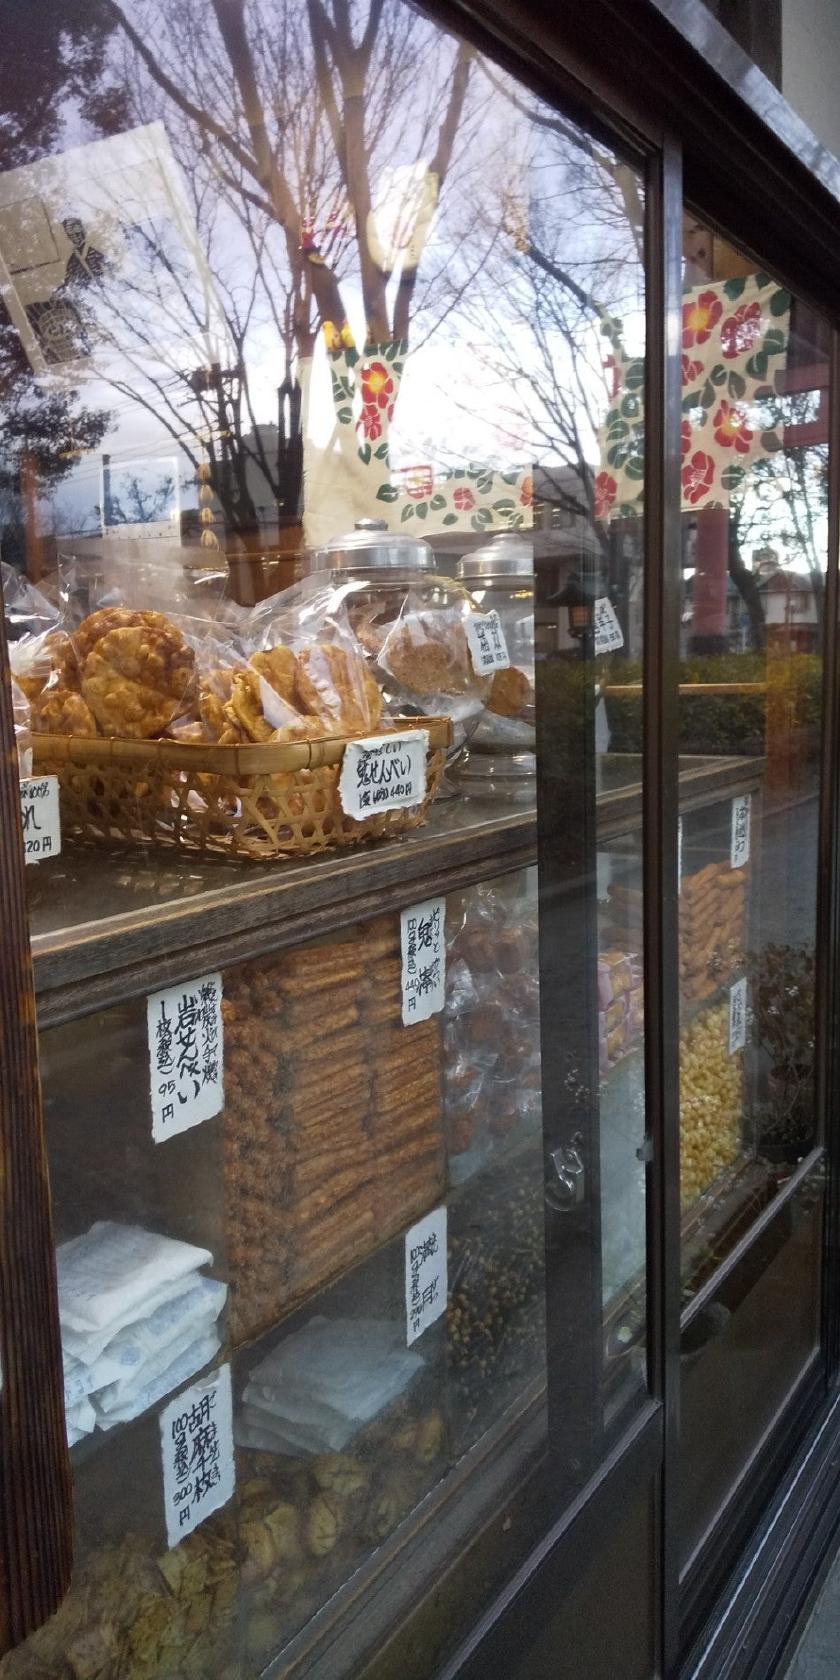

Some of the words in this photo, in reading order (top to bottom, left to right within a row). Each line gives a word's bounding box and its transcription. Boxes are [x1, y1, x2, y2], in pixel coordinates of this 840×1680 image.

[356, 754, 411, 788] 鬼せんべい
[174, 994, 201, 1104] 岩せんべい
[188, 1394, 218, 1505] 胡麻千枚
